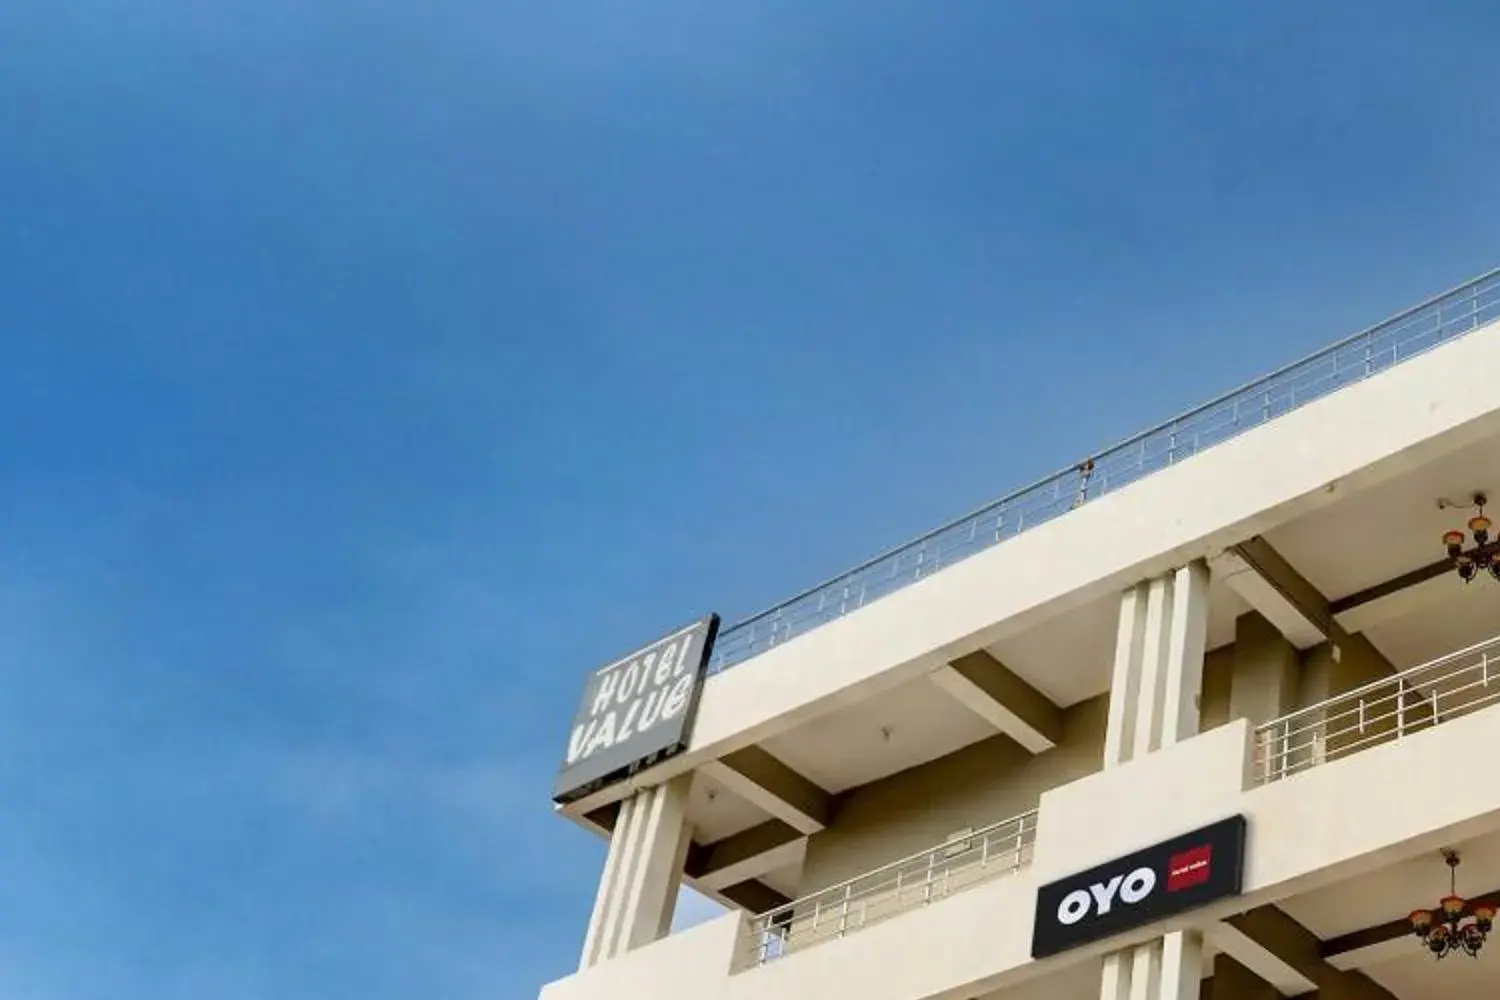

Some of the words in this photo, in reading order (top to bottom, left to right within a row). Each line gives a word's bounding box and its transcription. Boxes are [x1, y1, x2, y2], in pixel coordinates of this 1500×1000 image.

[591, 634, 693, 716] HOTEL
[567, 673, 692, 765] VALUE
[1057, 867, 1157, 925] OYO
